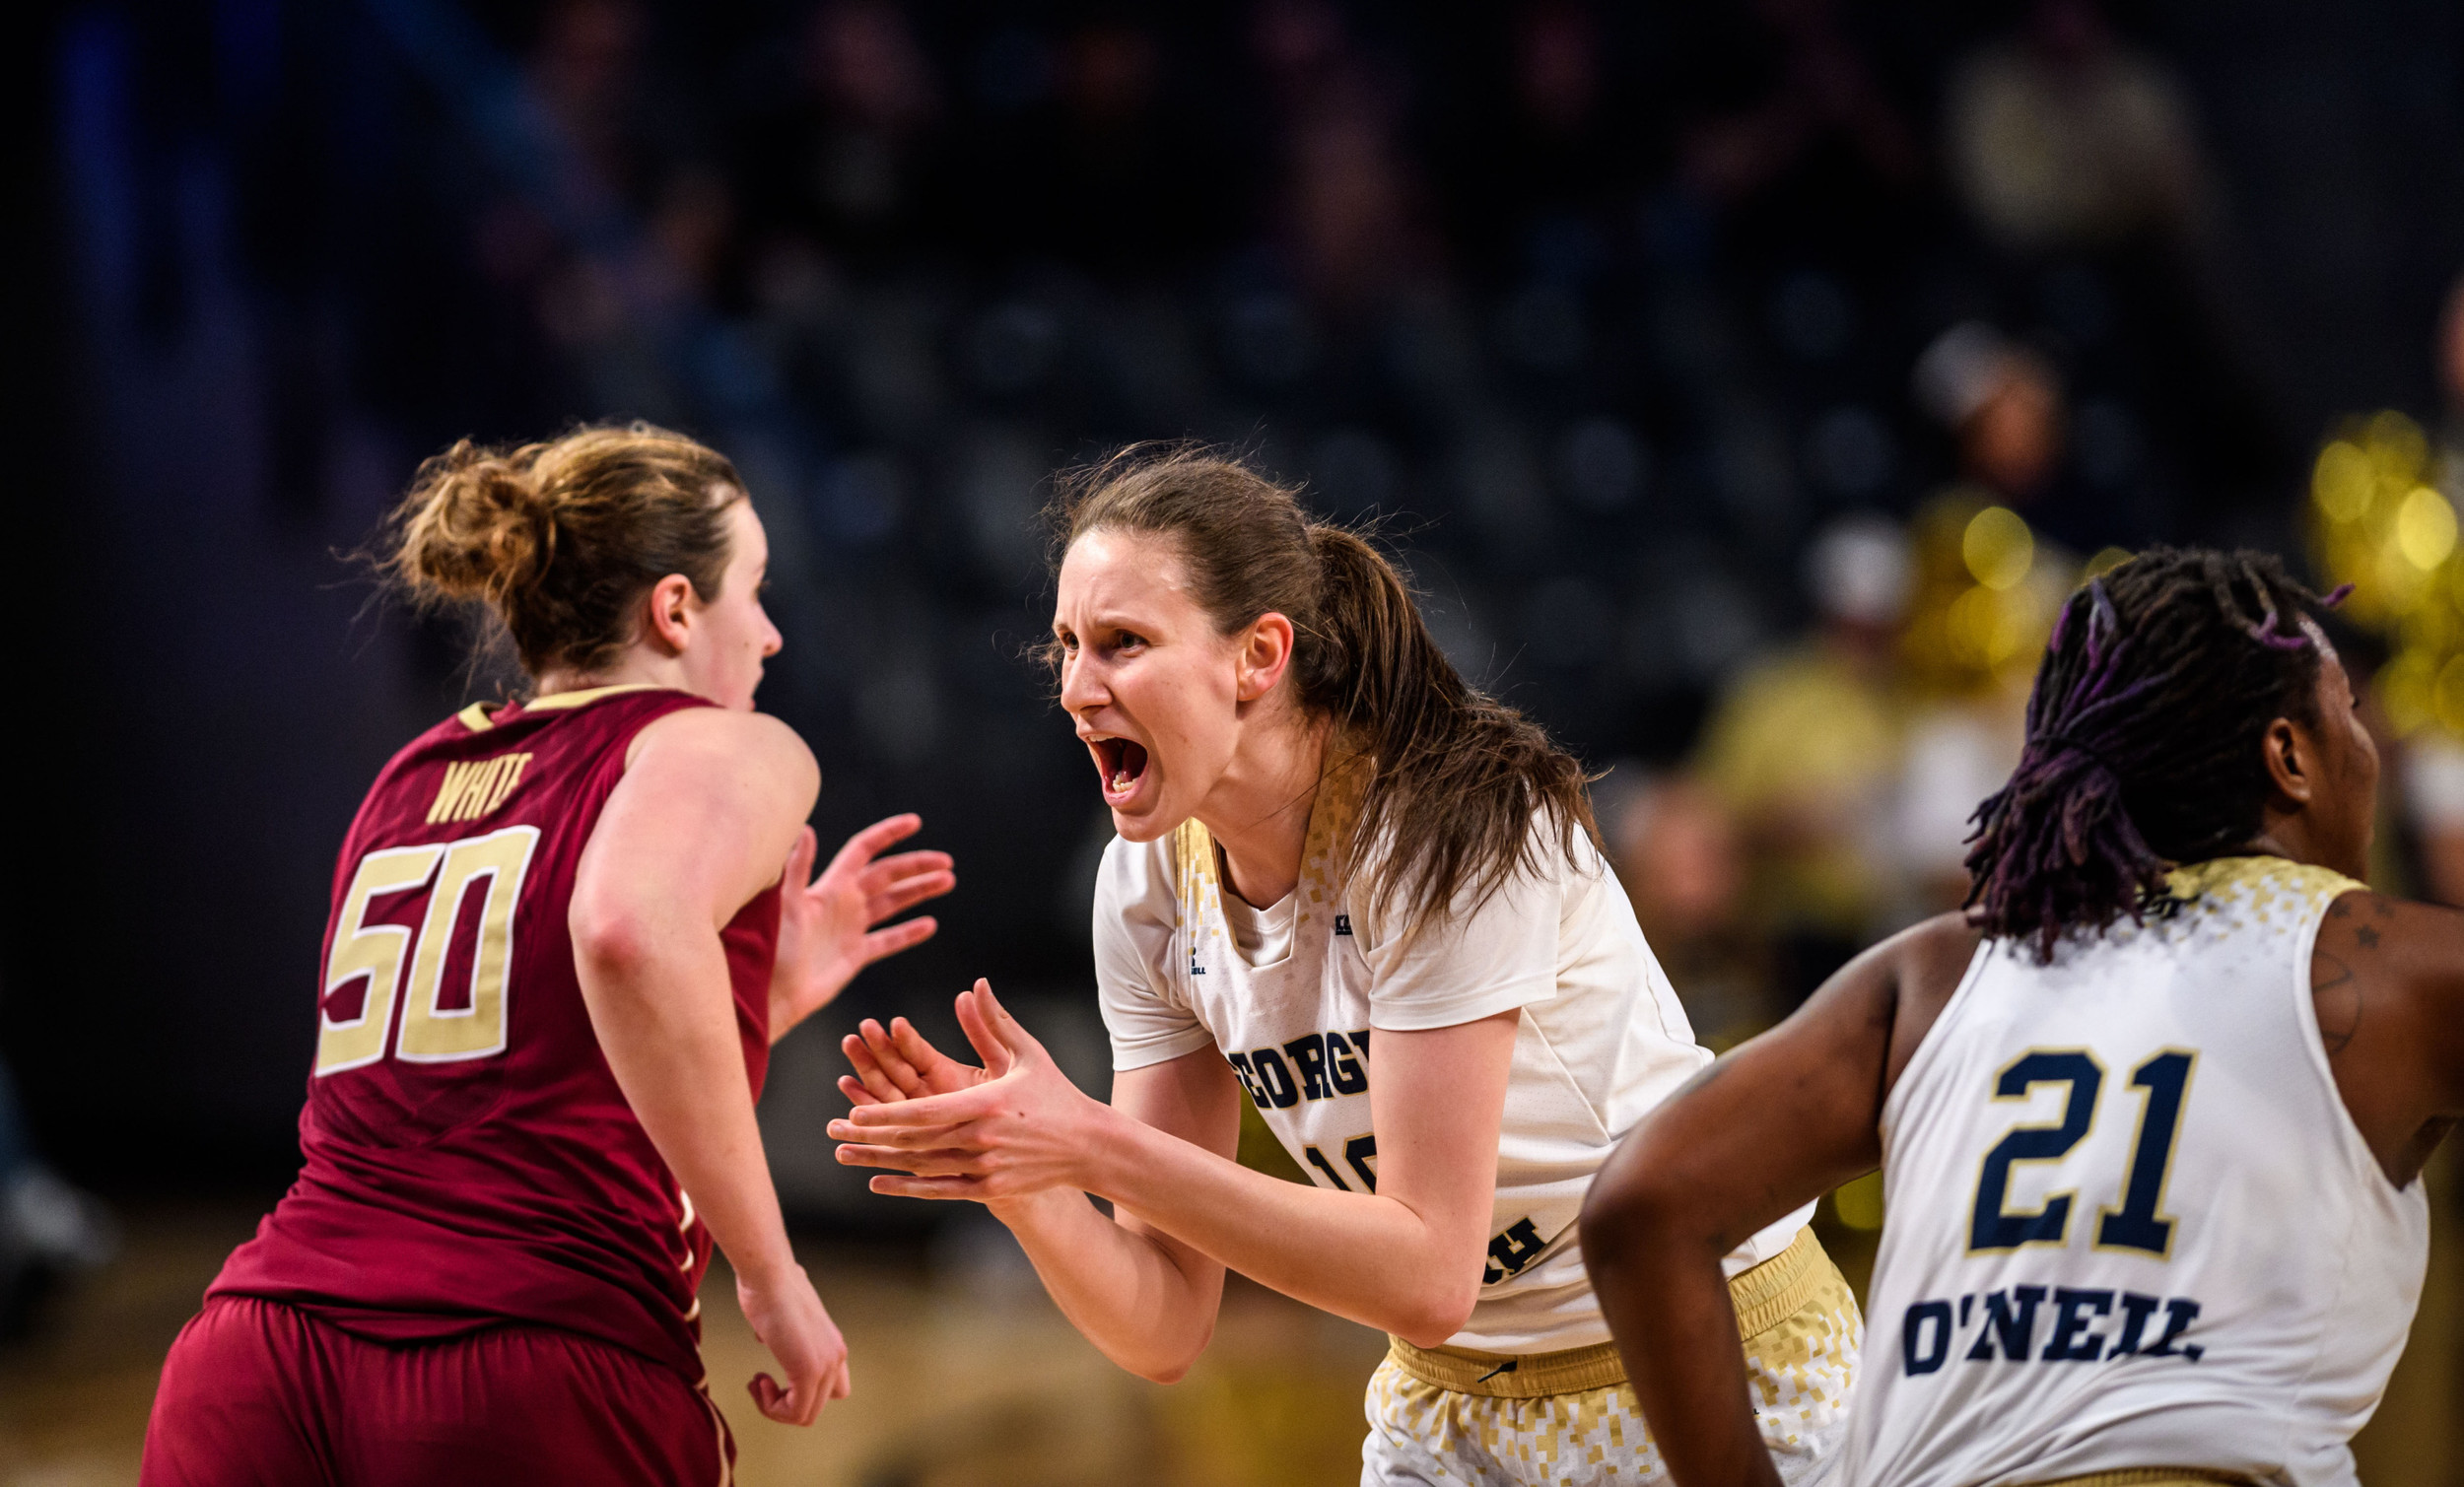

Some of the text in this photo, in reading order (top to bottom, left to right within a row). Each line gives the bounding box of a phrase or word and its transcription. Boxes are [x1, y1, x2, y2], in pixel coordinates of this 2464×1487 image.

[425, 752, 533, 825] WHITE
[314, 824, 541, 1078] 50
[1964, 1045, 2201, 1261] 21
[1902, 1282, 2206, 1377] O'NEIL
